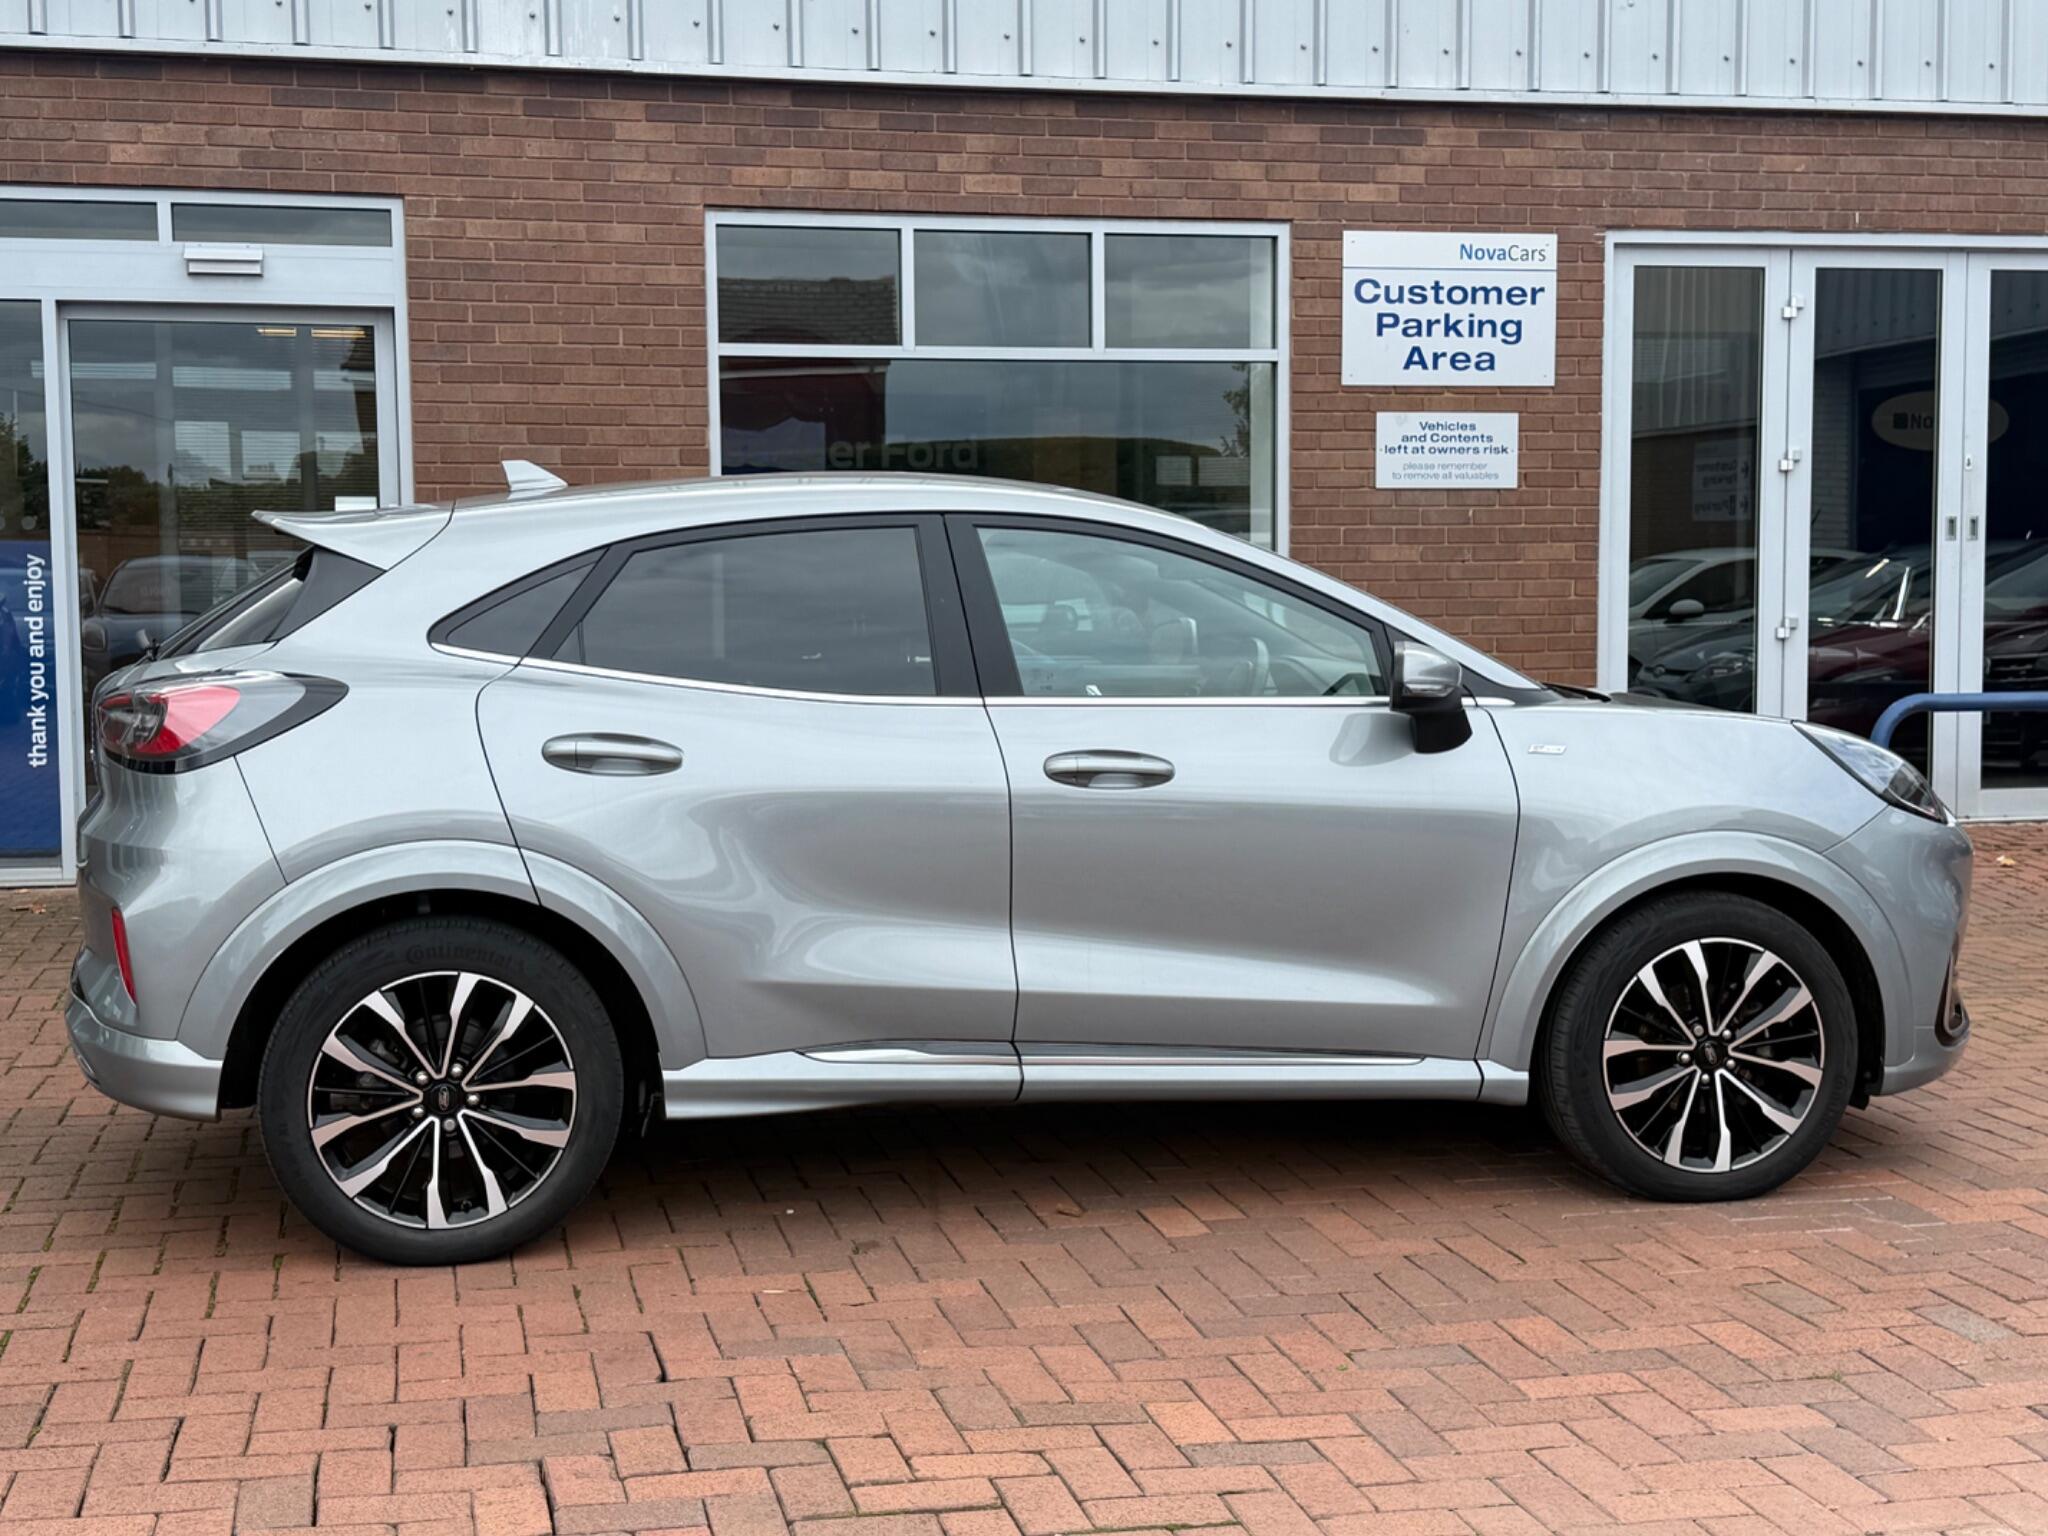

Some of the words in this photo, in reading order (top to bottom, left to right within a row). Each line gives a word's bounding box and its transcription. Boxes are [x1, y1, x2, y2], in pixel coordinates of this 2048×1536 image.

[1459, 243, 1546, 262] NovaCars
[1353, 277, 1545, 306] Customer
[1376, 312, 1523, 345] Parking
[1402, 346, 1496, 372] Area
[1401, 433, 1427, 443] and
[1430, 433, 1493, 443] Contents
[1419, 421, 1477, 431] Vehicles
[1384, 445, 1408, 454] left
[1411, 445, 1425, 454] at
[1428, 446, 1480, 455] owners
[1483, 445, 1509, 455] risk
[1392, 472, 1401, 480] to
[1442, 472, 1452, 480] all
[1454, 472, 1499, 480] valuables
[1402, 462, 1435, 471] please
[1437, 462, 1488, 470] remember
[23, 553, 46, 612] enjoy
[24, 616, 45, 658] and
[30, 662, 49, 701] you
[26, 705, 47, 768] thank
